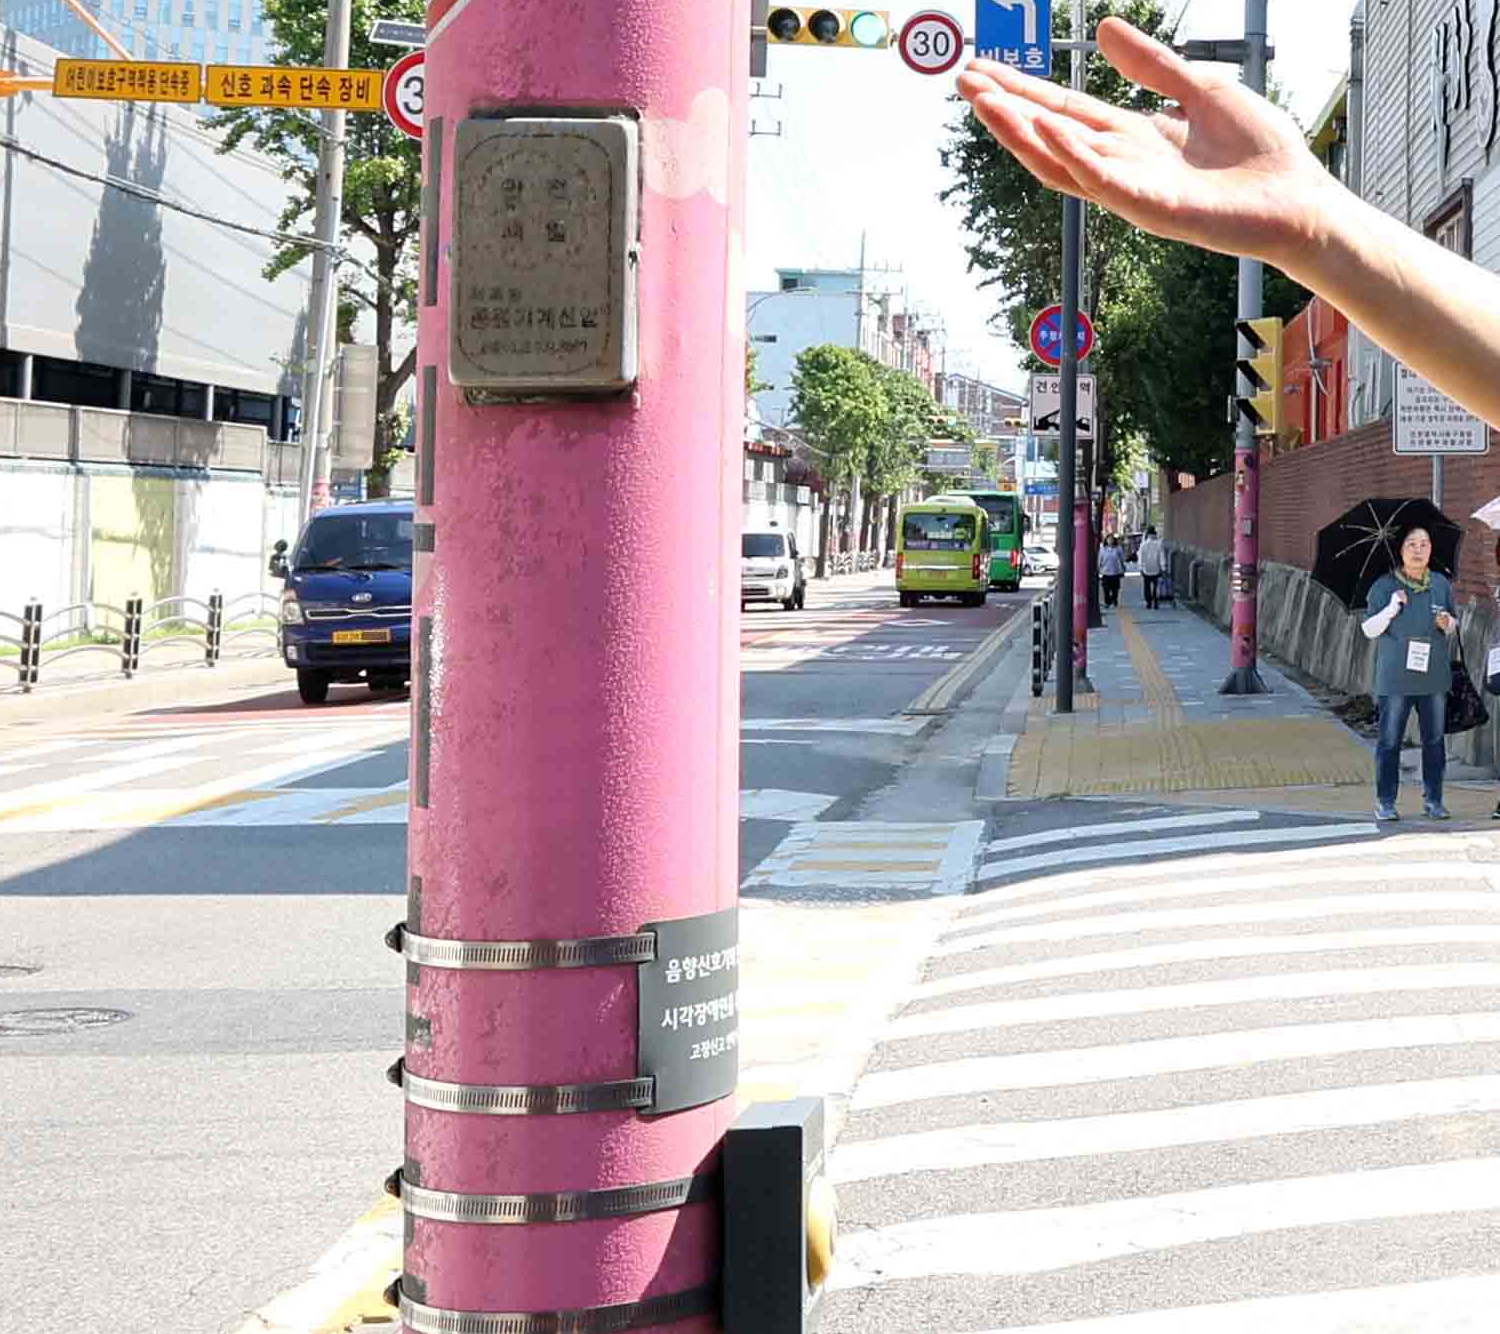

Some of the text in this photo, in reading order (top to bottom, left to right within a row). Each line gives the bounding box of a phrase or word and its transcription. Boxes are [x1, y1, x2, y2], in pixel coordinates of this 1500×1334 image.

[913, 31, 950, 57] 30
[980, 47, 1045, 69] 비보호
[221, 72, 370, 103] 신호 과속 단속 장비
[403, 75, 425, 115] 3
[1036, 380, 1092, 396] 견인역
